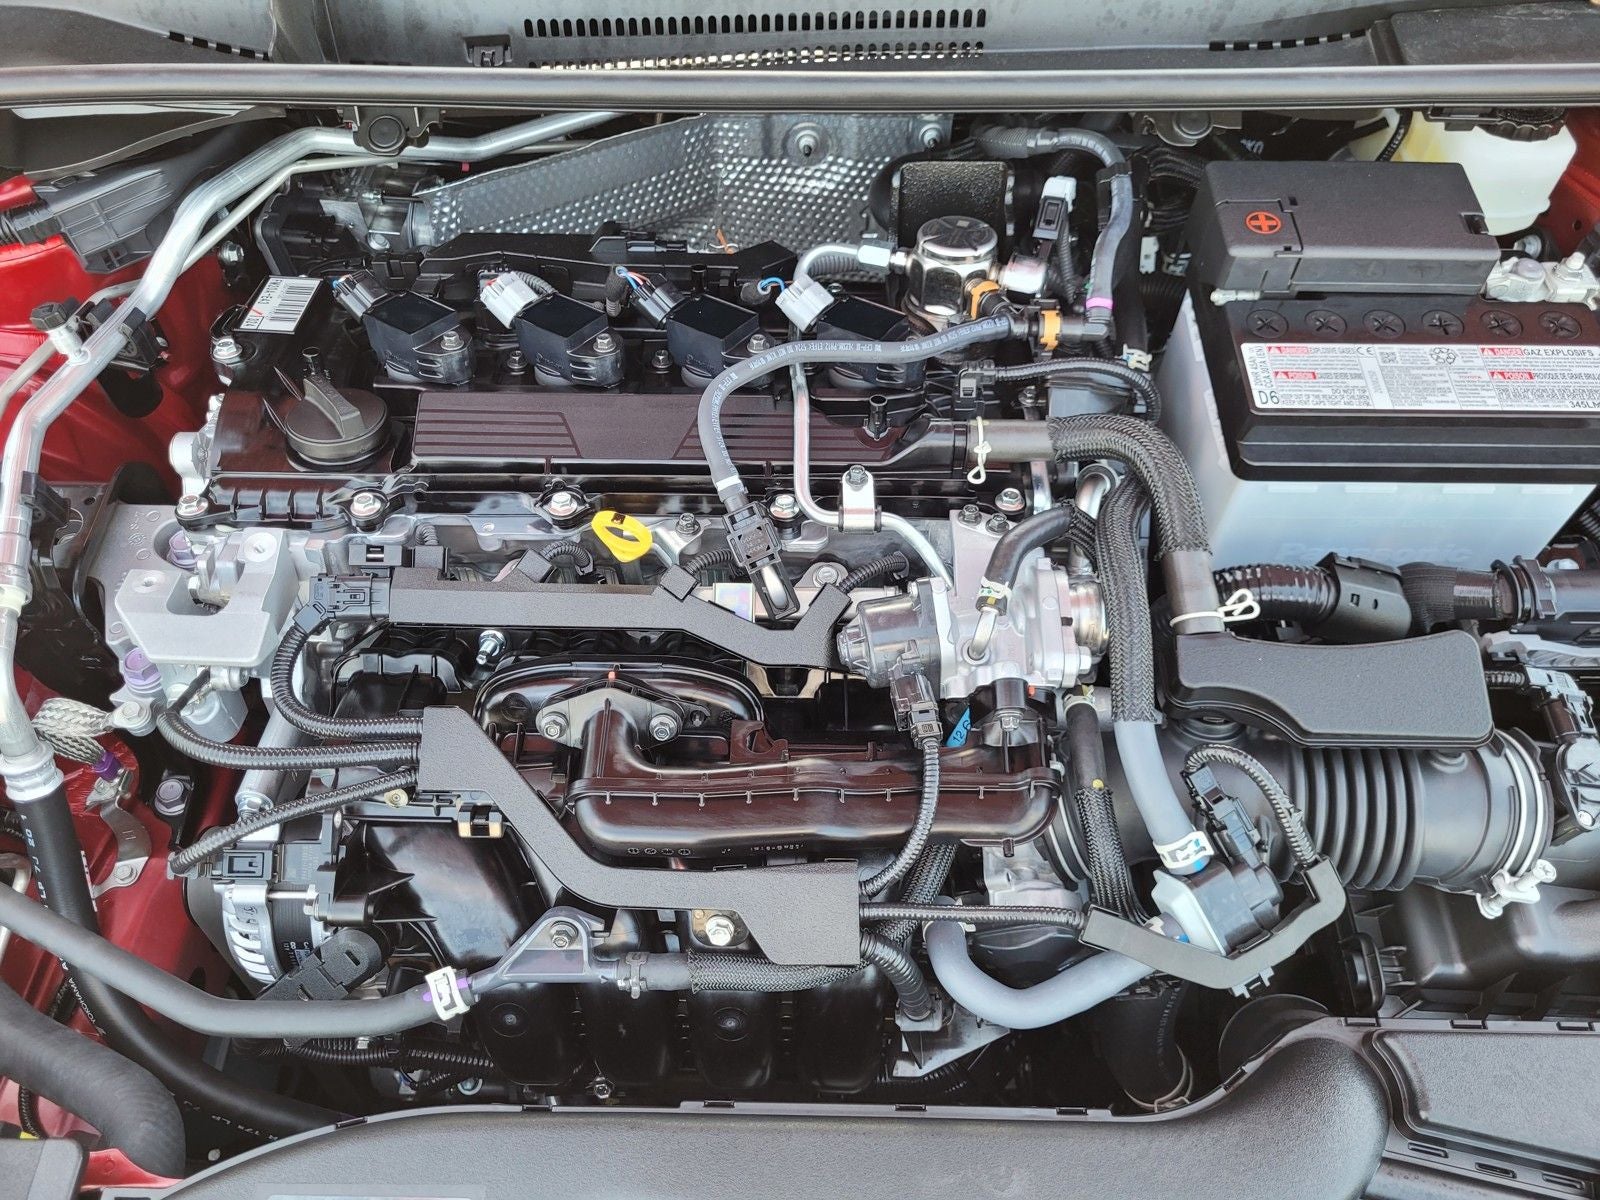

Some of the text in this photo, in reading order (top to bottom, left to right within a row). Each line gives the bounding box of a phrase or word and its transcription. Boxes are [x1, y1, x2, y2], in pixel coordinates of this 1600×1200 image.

[1495, 348, 1523, 356] DANGER
[1545, 349, 1594, 357] EXPLOSIFS
[1504, 371, 1530, 380] POISON
[1258, 390, 1280, 405] D6
[953, 730, 964, 742] 12
[68, 977, 97, 1024] YOKOHAMA
